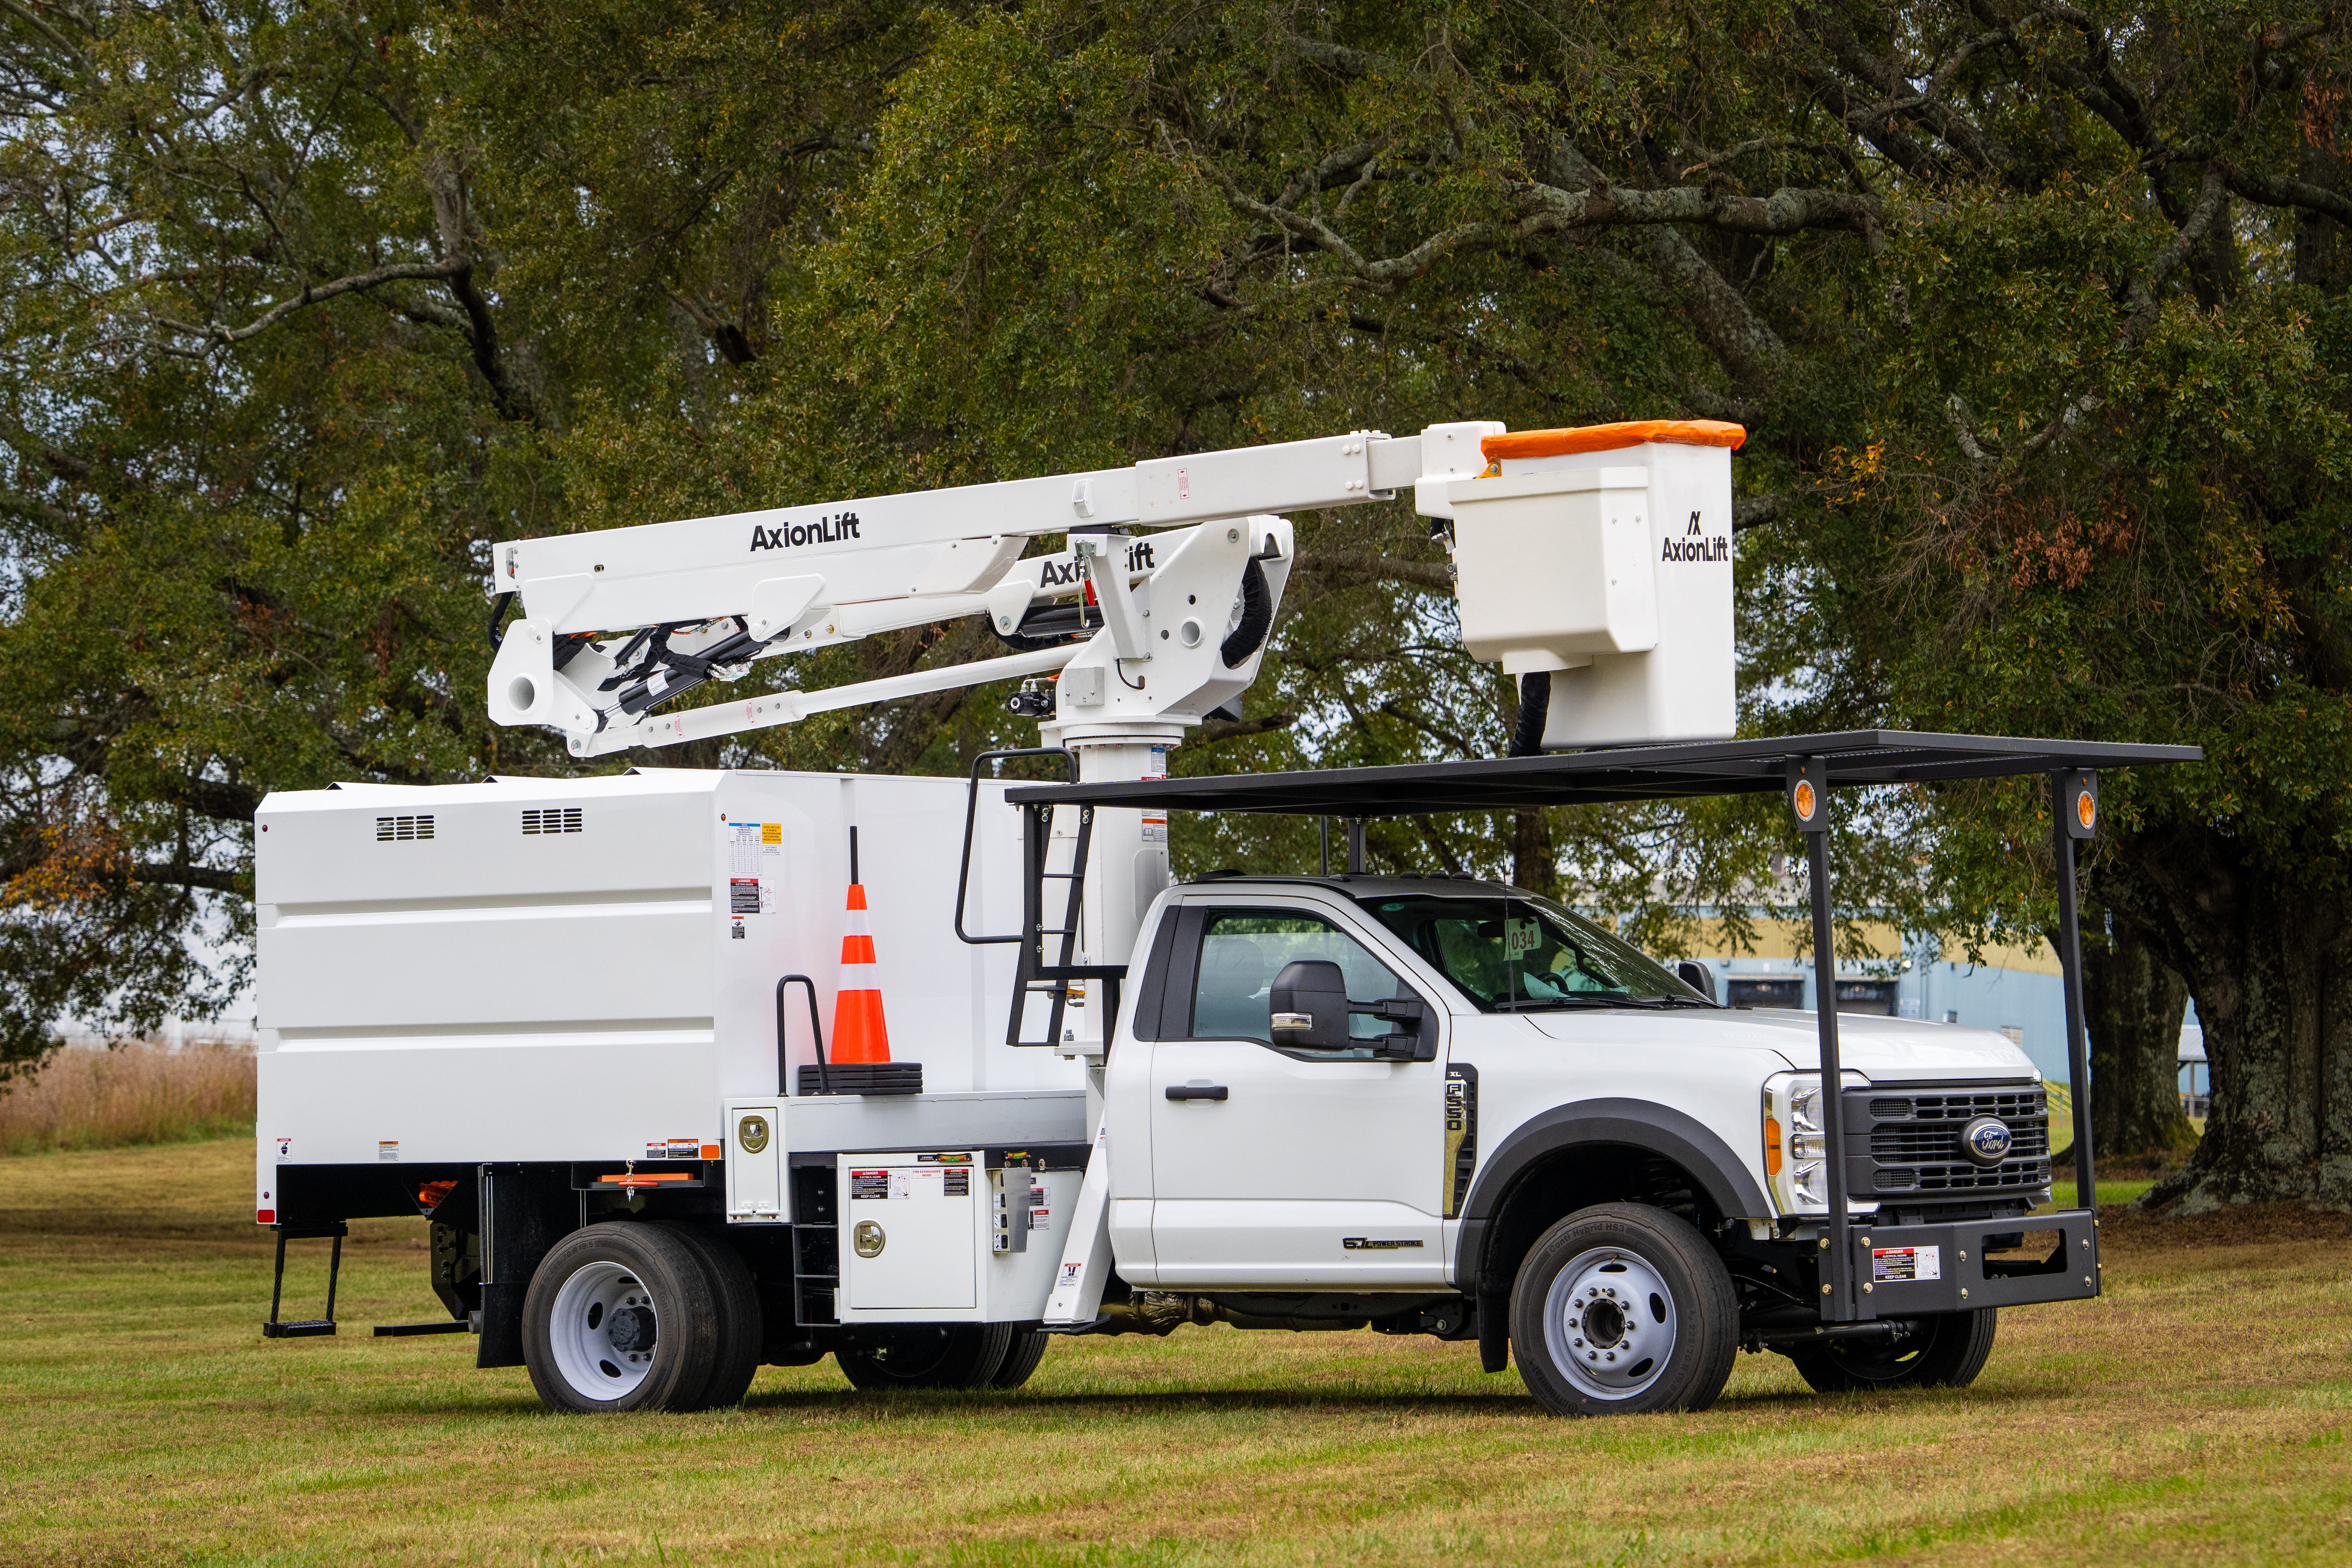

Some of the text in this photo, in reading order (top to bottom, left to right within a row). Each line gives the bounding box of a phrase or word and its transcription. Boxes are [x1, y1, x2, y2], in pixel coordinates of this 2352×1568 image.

[750, 511, 860, 552] AxionLift
[1662, 536, 1728, 562] AxionLift
[1040, 542, 1155, 588] Axiift
[1511, 930, 1535, 950] 034
[1982, 1131, 2004, 1150] Ford
[1549, 1223, 1625, 1253] Conti Hybrid HS3
